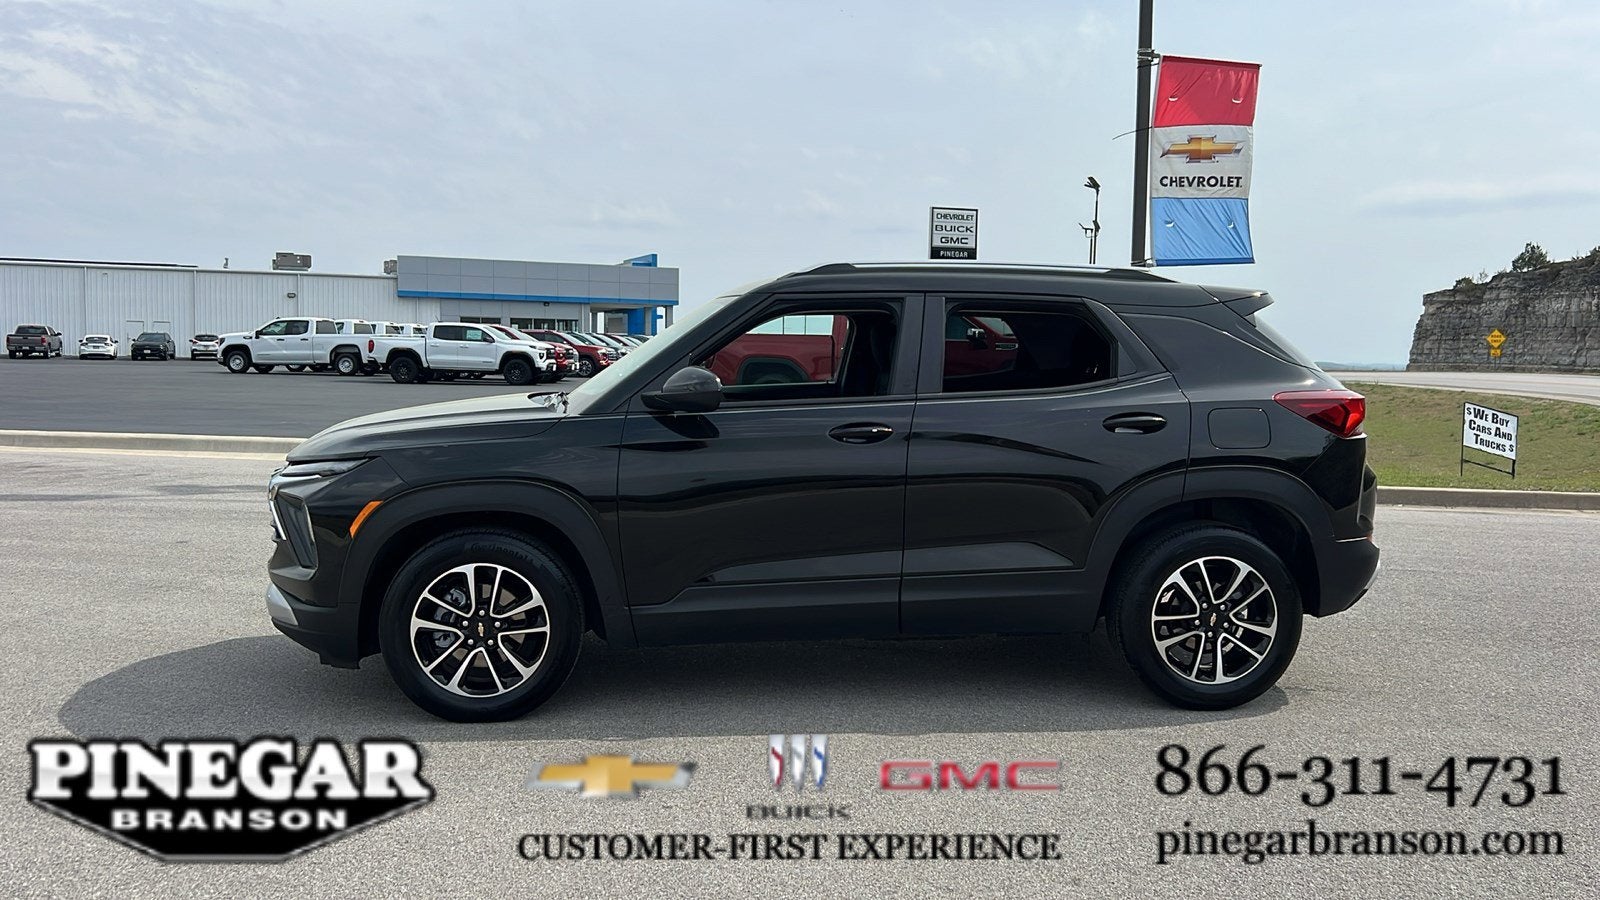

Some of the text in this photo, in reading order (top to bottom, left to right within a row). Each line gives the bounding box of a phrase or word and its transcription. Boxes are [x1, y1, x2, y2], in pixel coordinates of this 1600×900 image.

[1160, 176, 1242, 188] CHEVROLET
[936, 213, 974, 221] CHEVROLET
[935, 225, 974, 233] BUICK
